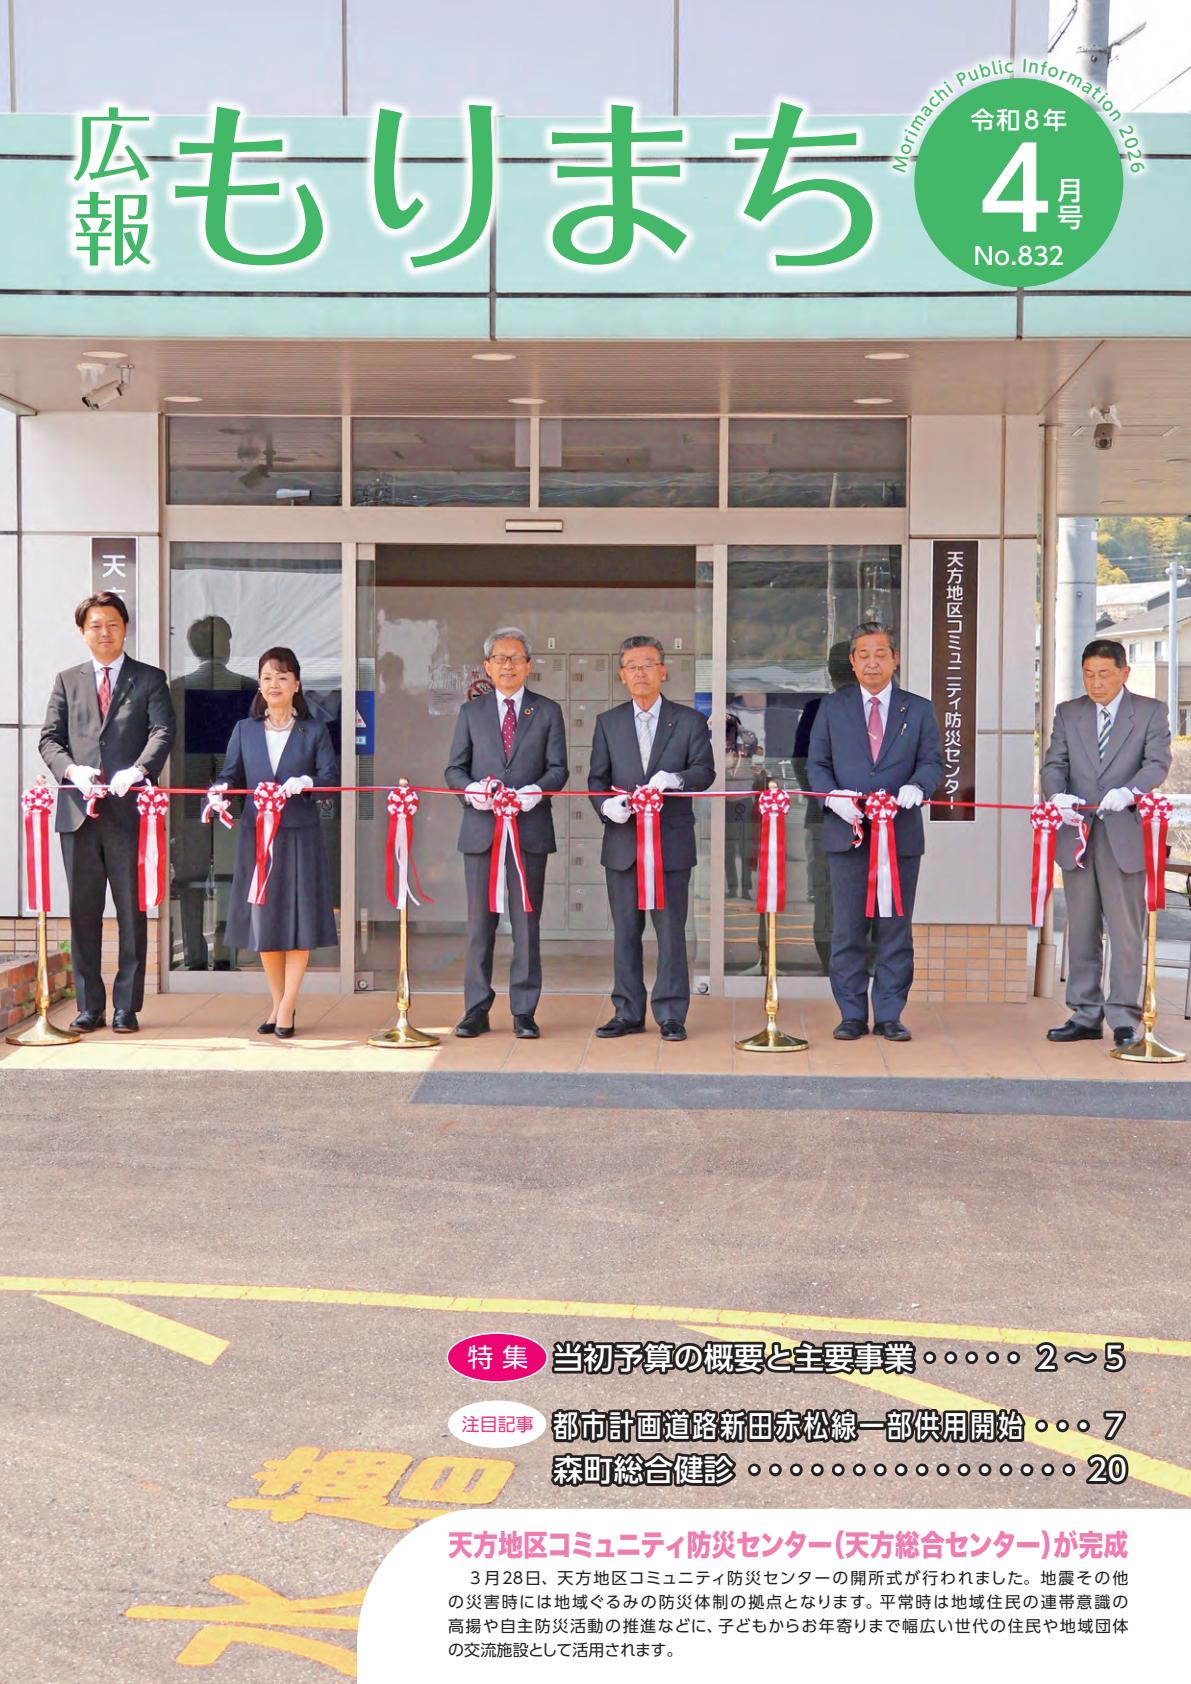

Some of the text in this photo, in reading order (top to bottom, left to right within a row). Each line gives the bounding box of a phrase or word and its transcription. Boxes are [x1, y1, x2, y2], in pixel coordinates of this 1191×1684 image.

[945, 551, 964, 810] 天方地区コミュニティ防災センター
